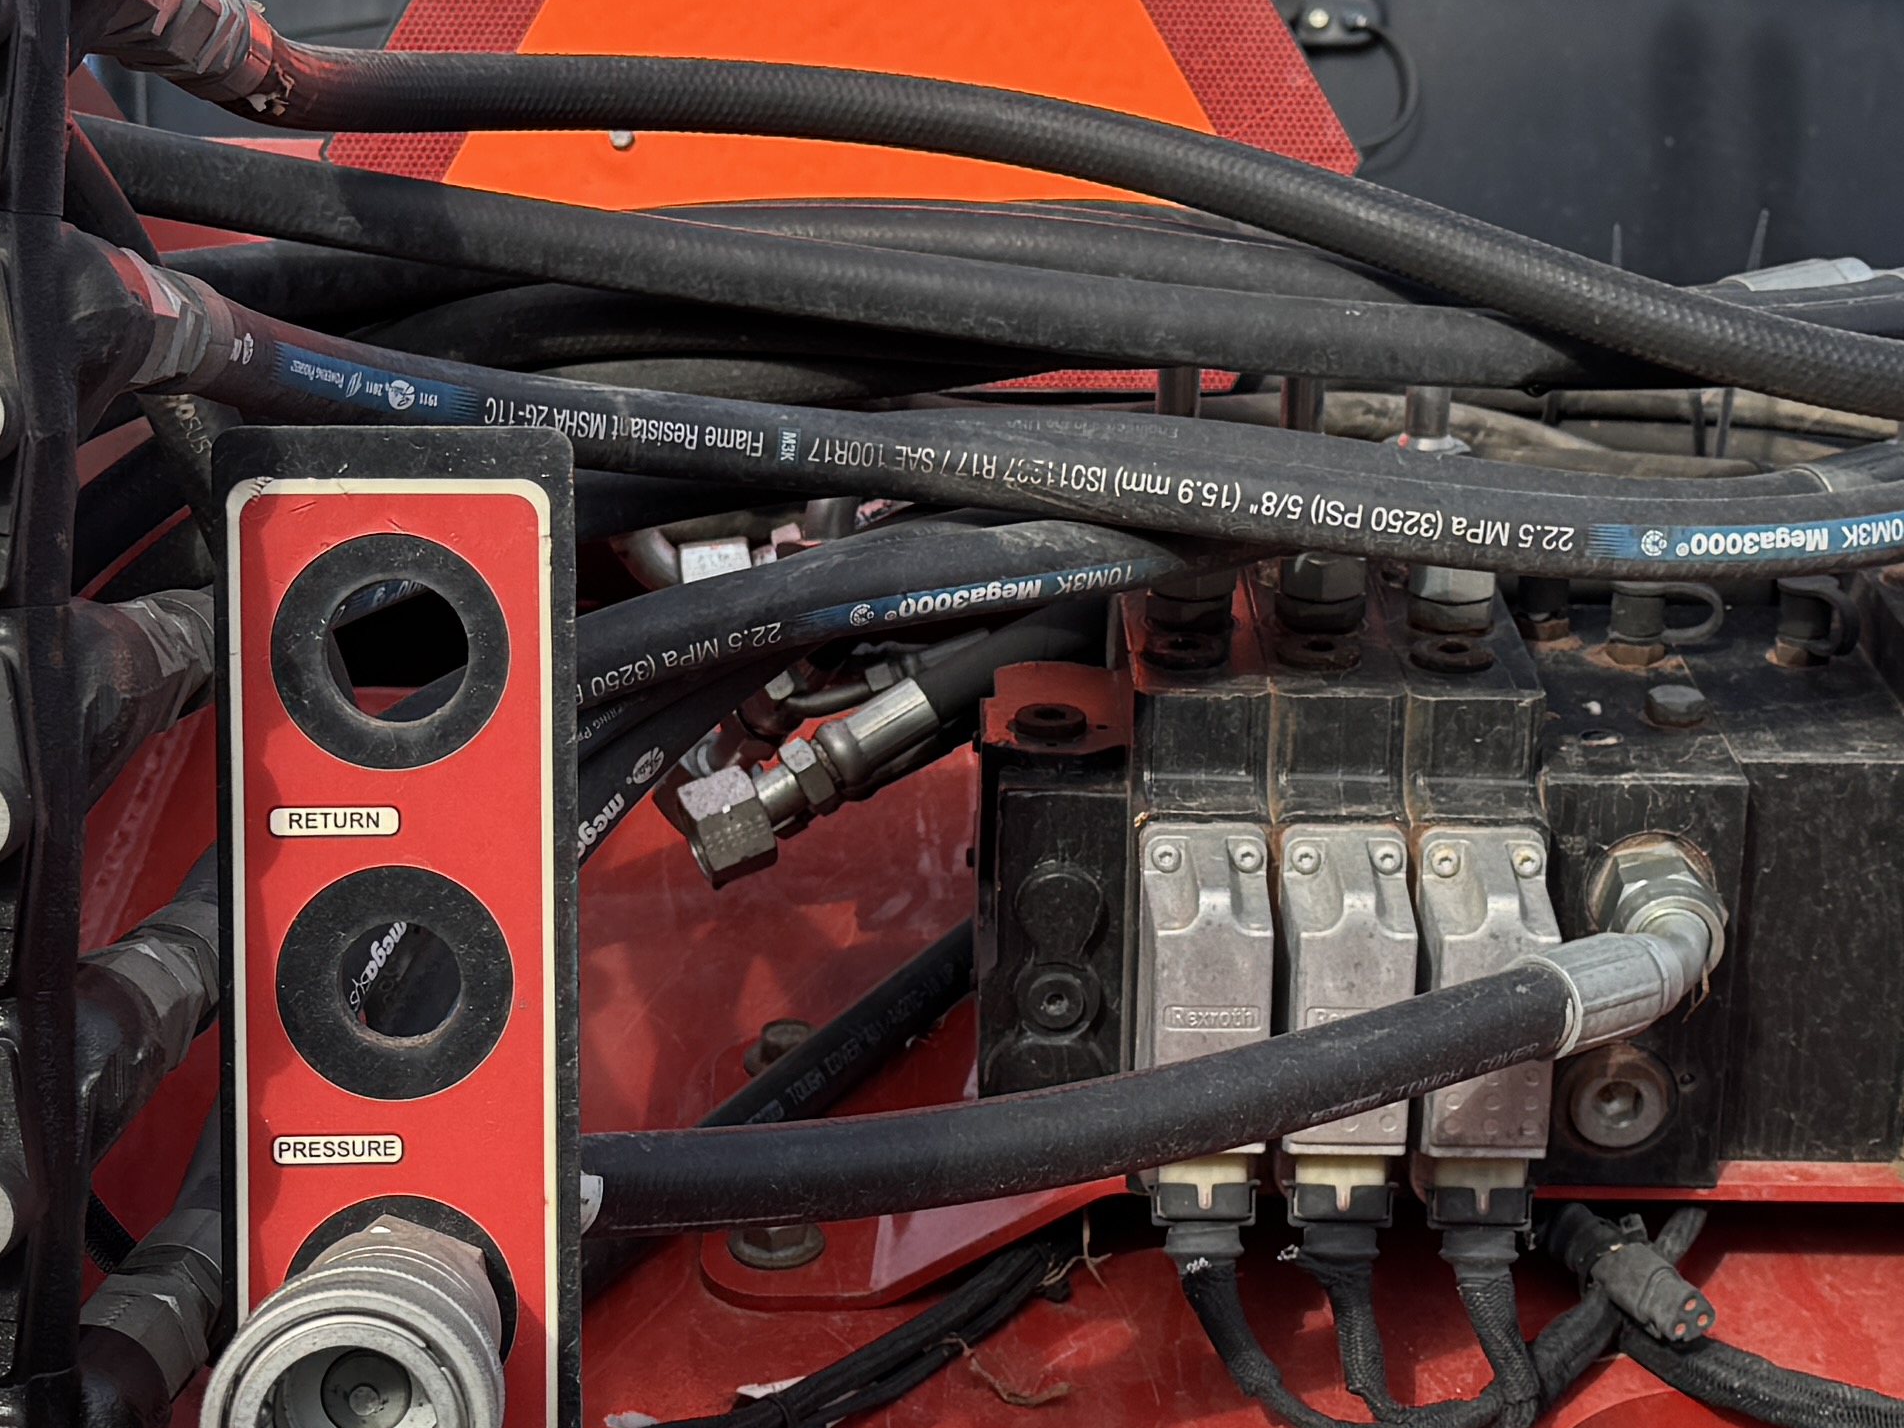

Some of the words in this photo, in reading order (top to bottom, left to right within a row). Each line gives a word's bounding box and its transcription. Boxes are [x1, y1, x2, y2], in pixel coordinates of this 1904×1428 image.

[482, 396, 549, 427] 2G-11C
[552, 408, 608, 440] MSHA
[610, 415, 699, 450] Resistant
[704, 425, 764, 458] Flame
[806, 436, 886, 469] 100R17
[893, 443, 936, 474] SAE
[952, 450, 999, 481] R17
[1112, 465, 1171, 498] mm)
[1176, 477, 1242, 514] (15.9
[1247, 489, 1305, 520] 5/8"
[1310, 492, 1364, 530] PSI)
[1370, 505, 1443, 542] (3250
[1450, 514, 1511, 548] MPa
[1517, 521, 1576, 553] 22.5
[1054, 563, 1135, 596] 10M3K
[660, 635, 721, 669] MPa
[726, 619, 783, 652] 22.5
[589, 650, 656, 697] (3250
[288, 812, 380, 829] RETURN
[1171, 1005, 1255, 1028] Rexroth
[278, 1140, 396, 1160] PRESSURE
